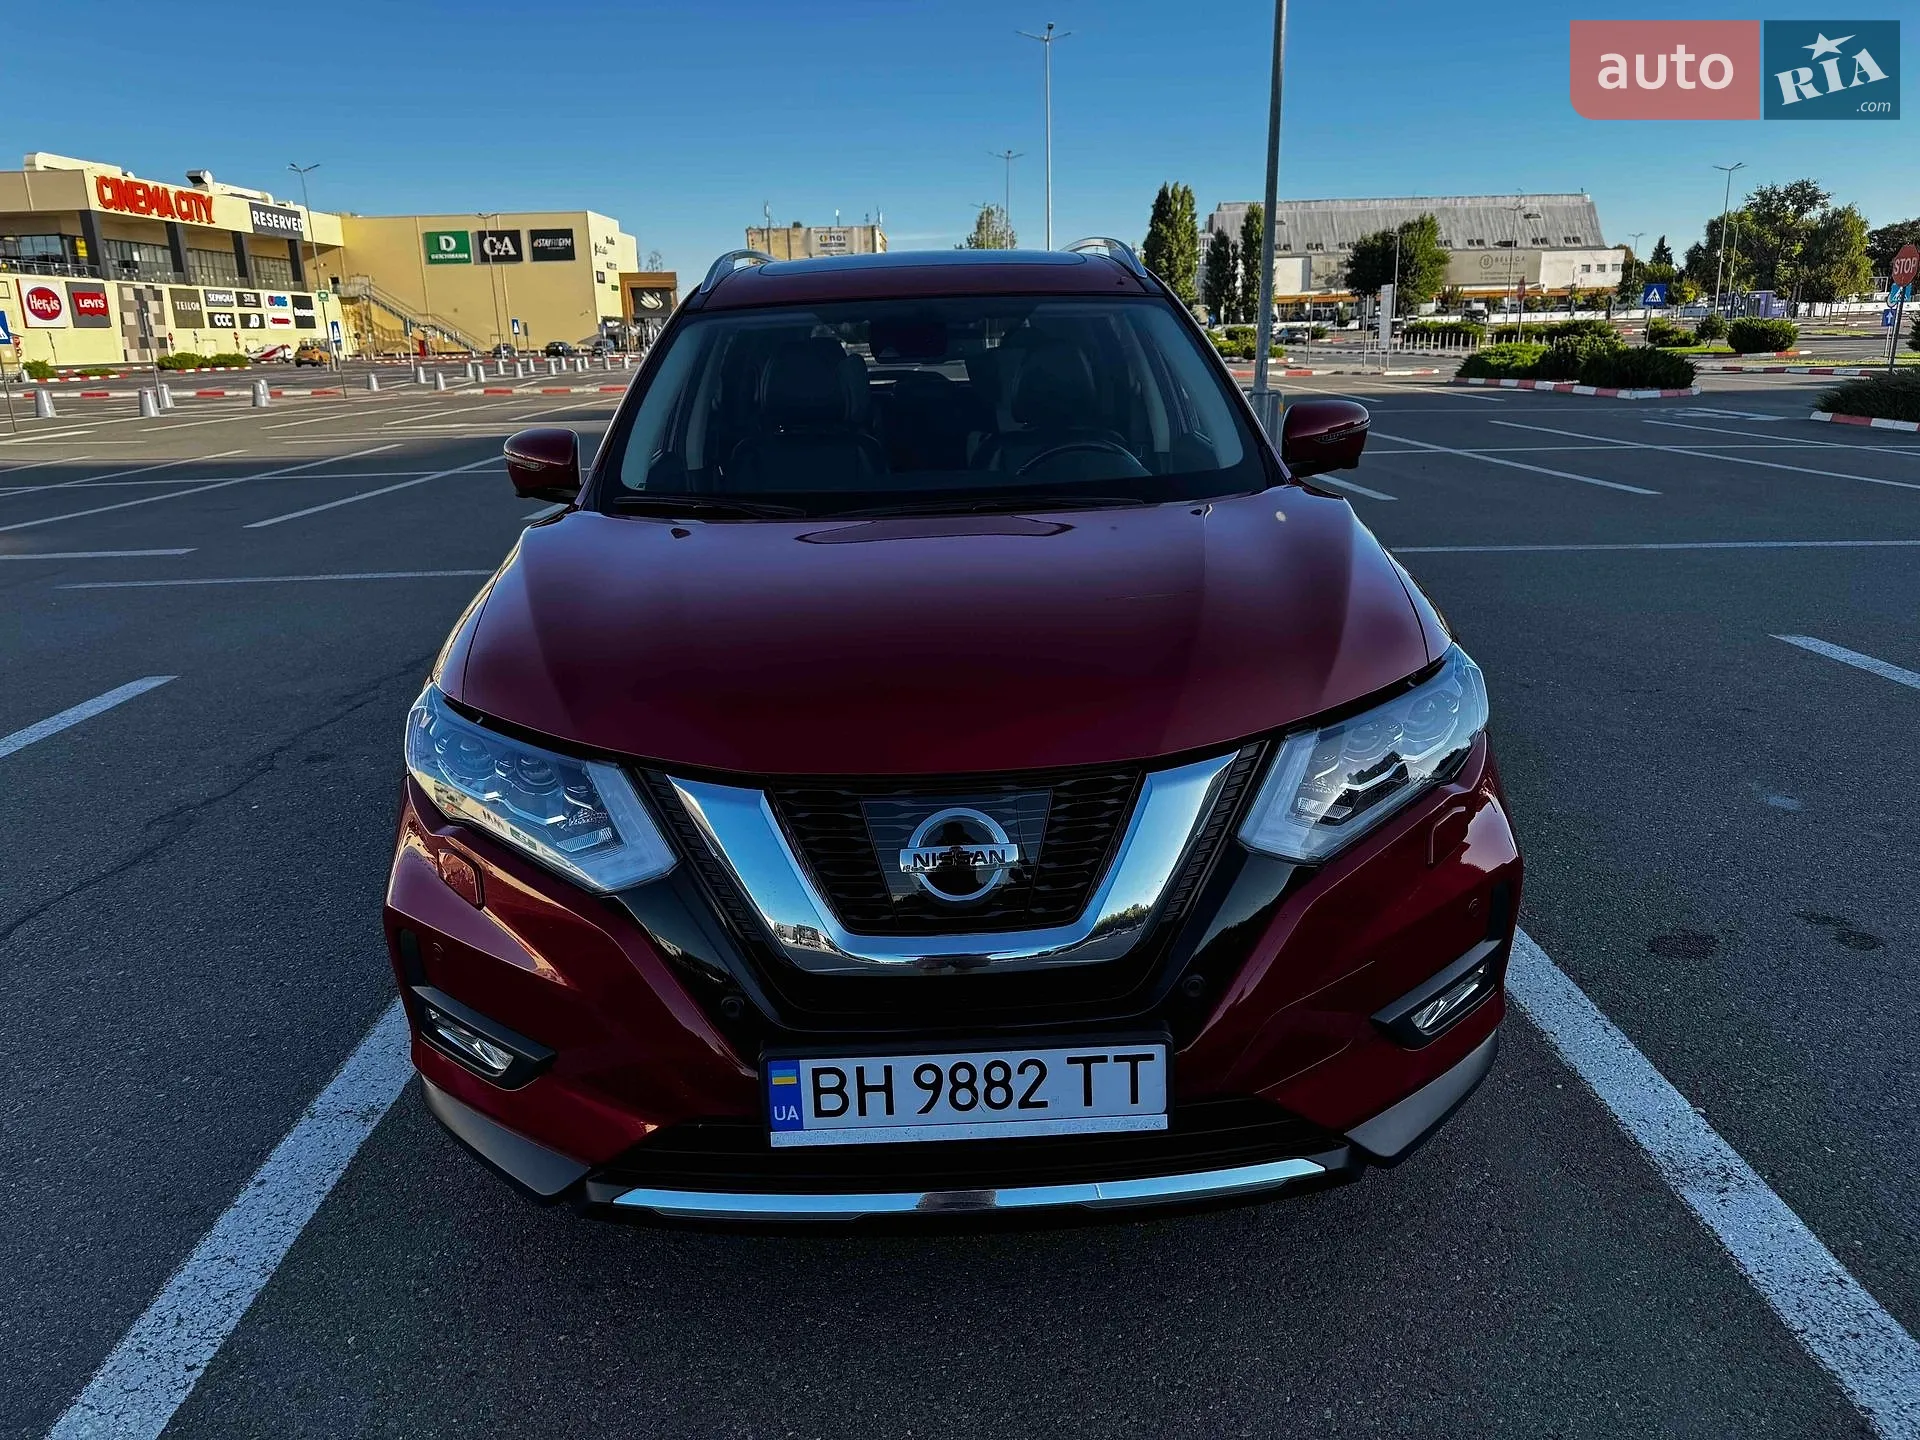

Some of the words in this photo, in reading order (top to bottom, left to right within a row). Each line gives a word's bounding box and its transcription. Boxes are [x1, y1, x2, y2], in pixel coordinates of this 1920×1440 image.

[97, 176, 176, 218] CINEMA
[174, 191, 216, 225] CITY
[252, 210, 304, 232] RESERVED
[438, 235, 456, 252] D
[482, 236, 516, 256] C&A
[1894, 257, 1918, 275] STOP
[214, 314, 233, 327] CCC
[912, 849, 1007, 869] NISSAN
[809, 1063, 896, 1119] BH
[912, 1058, 1049, 1115] 9882
[1066, 1053, 1156, 1108] TT
[774, 1105, 800, 1122] UA
